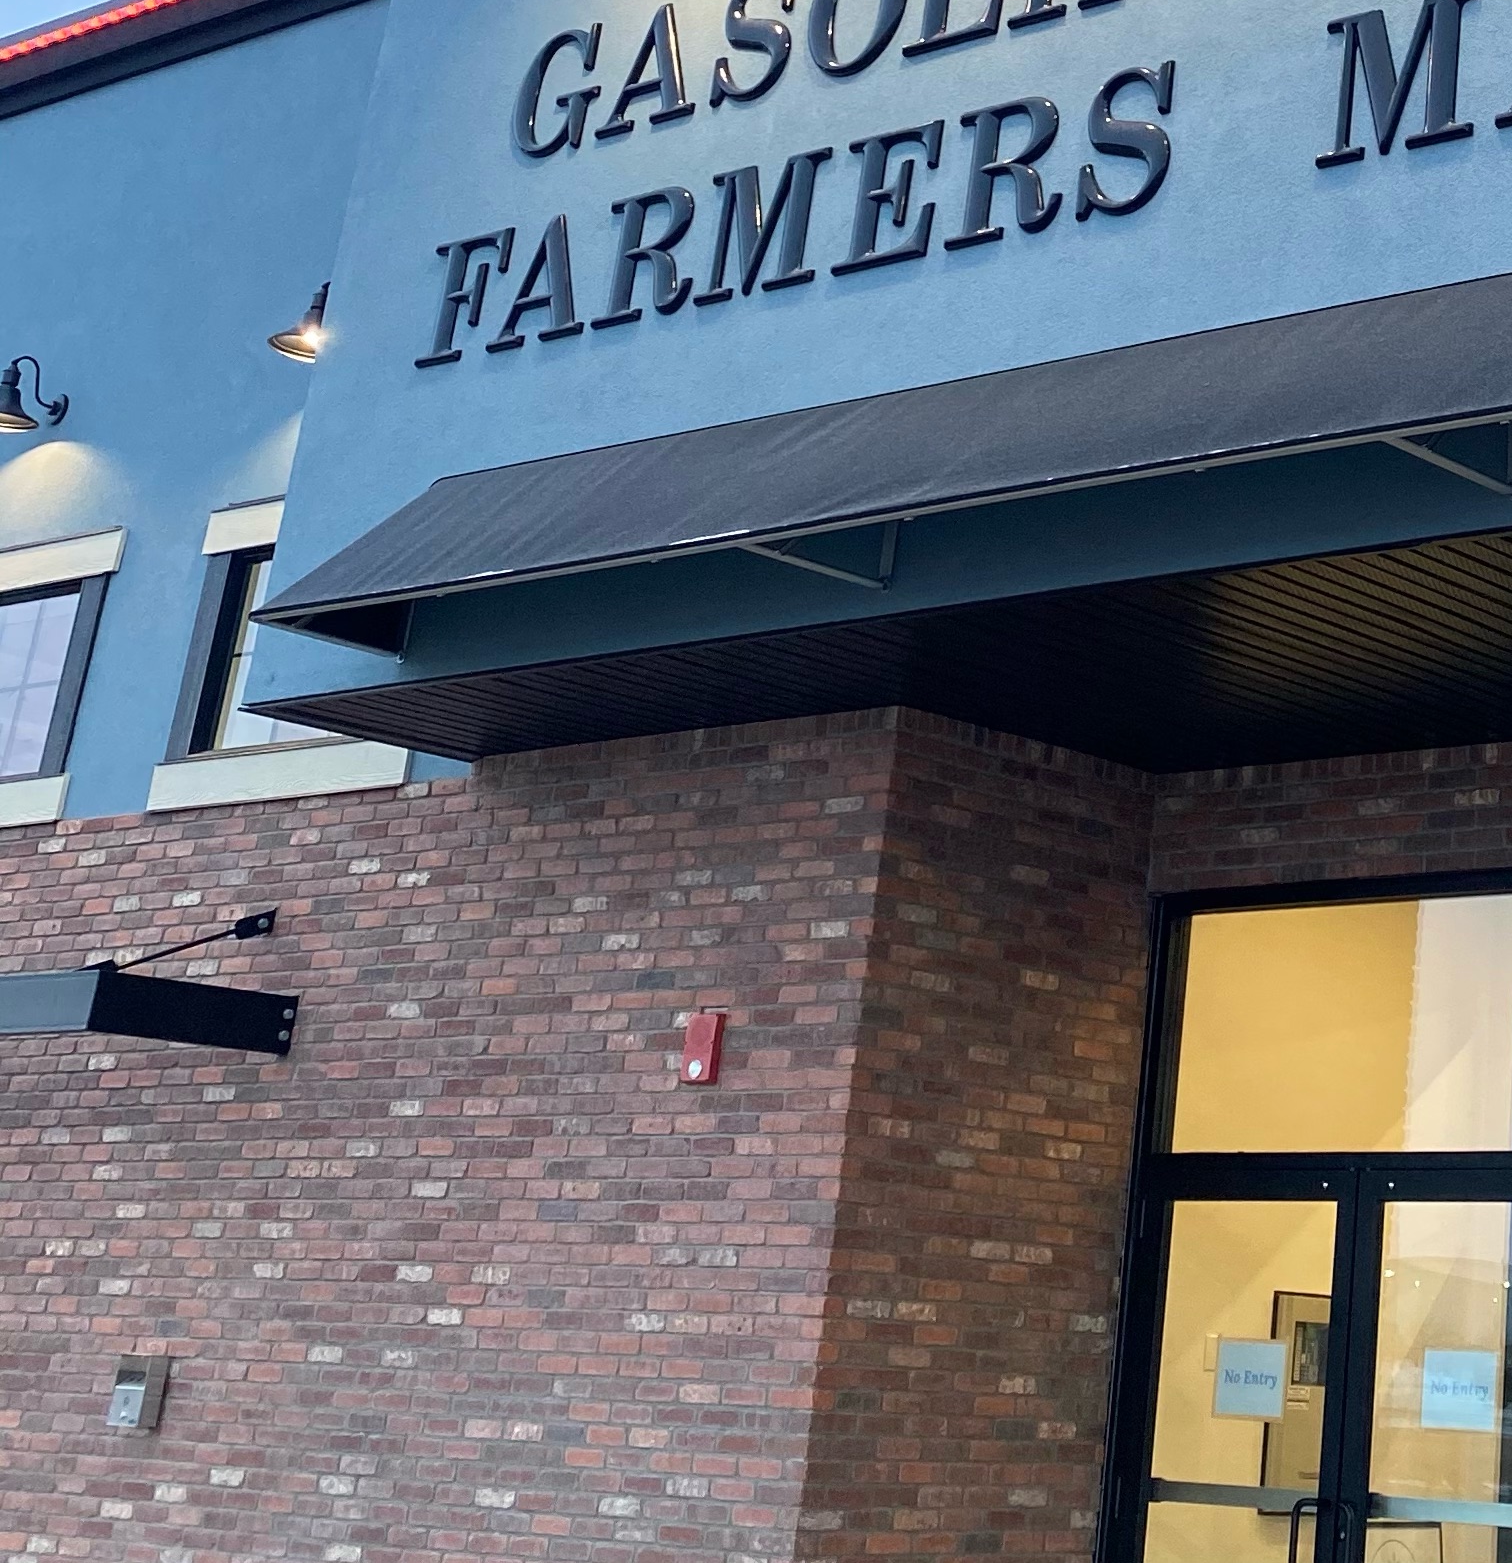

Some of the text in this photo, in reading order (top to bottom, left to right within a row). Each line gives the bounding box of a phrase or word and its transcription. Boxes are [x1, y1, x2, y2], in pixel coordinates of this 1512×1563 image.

[414, 59, 1177, 368] FARMERS
[1224, 1369, 1277, 1390] No Entry
[1430, 1380, 1489, 1402] No Entry
